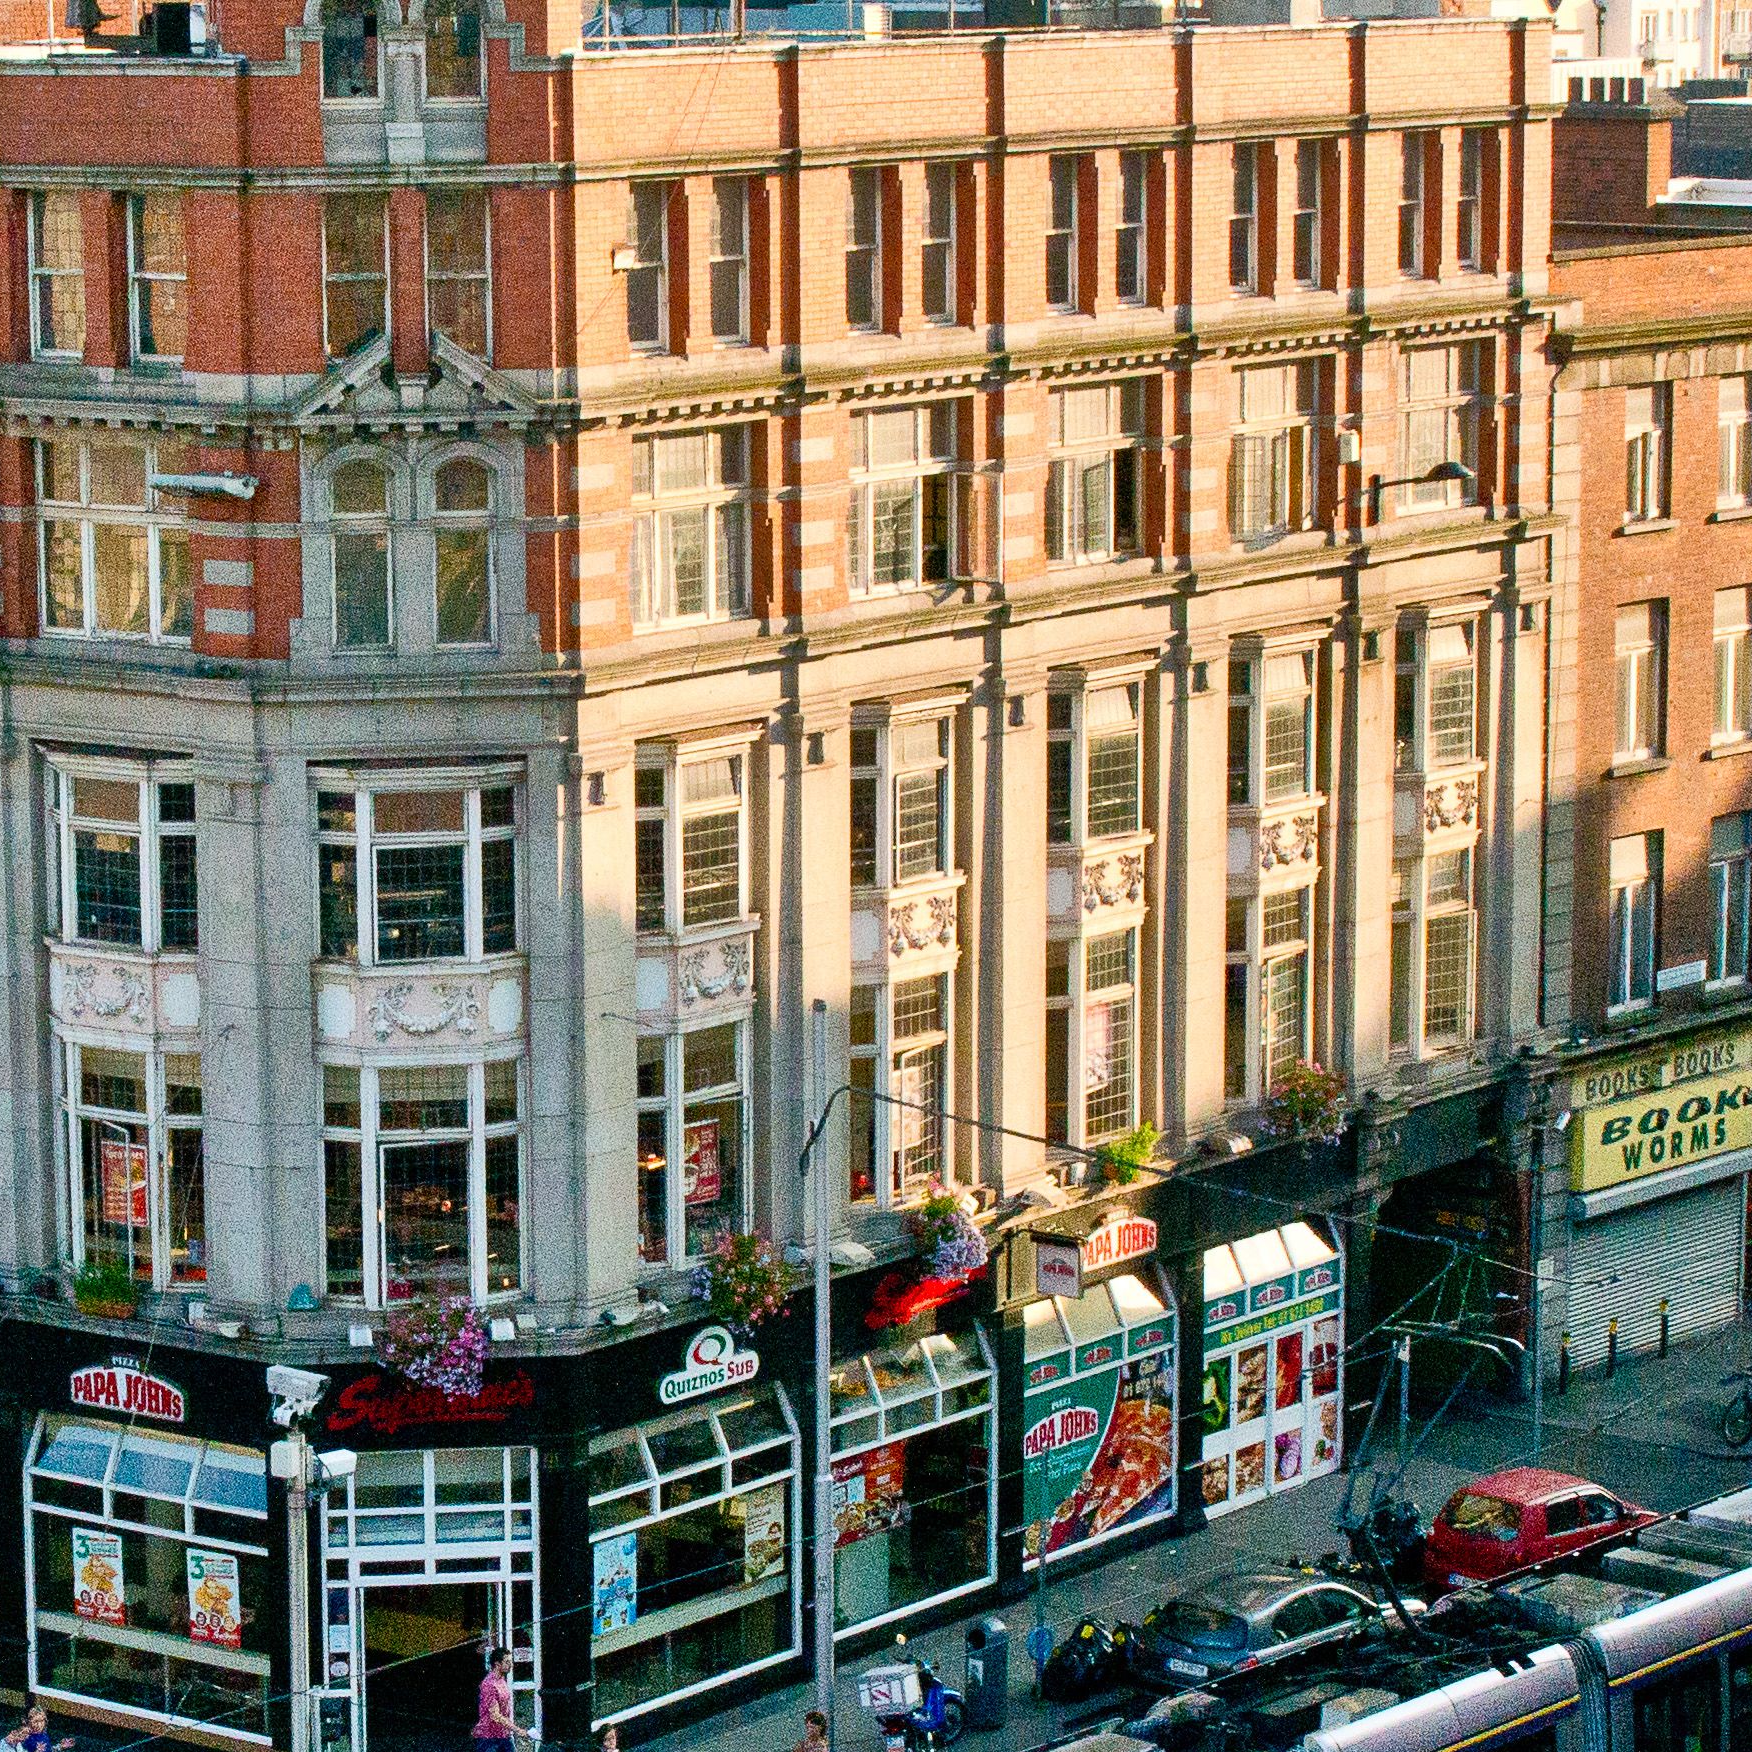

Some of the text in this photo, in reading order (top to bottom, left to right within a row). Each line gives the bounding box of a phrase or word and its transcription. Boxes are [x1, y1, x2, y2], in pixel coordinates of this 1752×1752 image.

[1585, 1042, 1735, 1100] BOOKS BOOKS
[1623, 1118, 1726, 1171] WORMS
[73, 1371, 119, 1407] PAPA
[1025, 1417, 1056, 1456] PAPA
[75, 1534, 90, 1559] 3
[190, 1555, 205, 1580] 3
